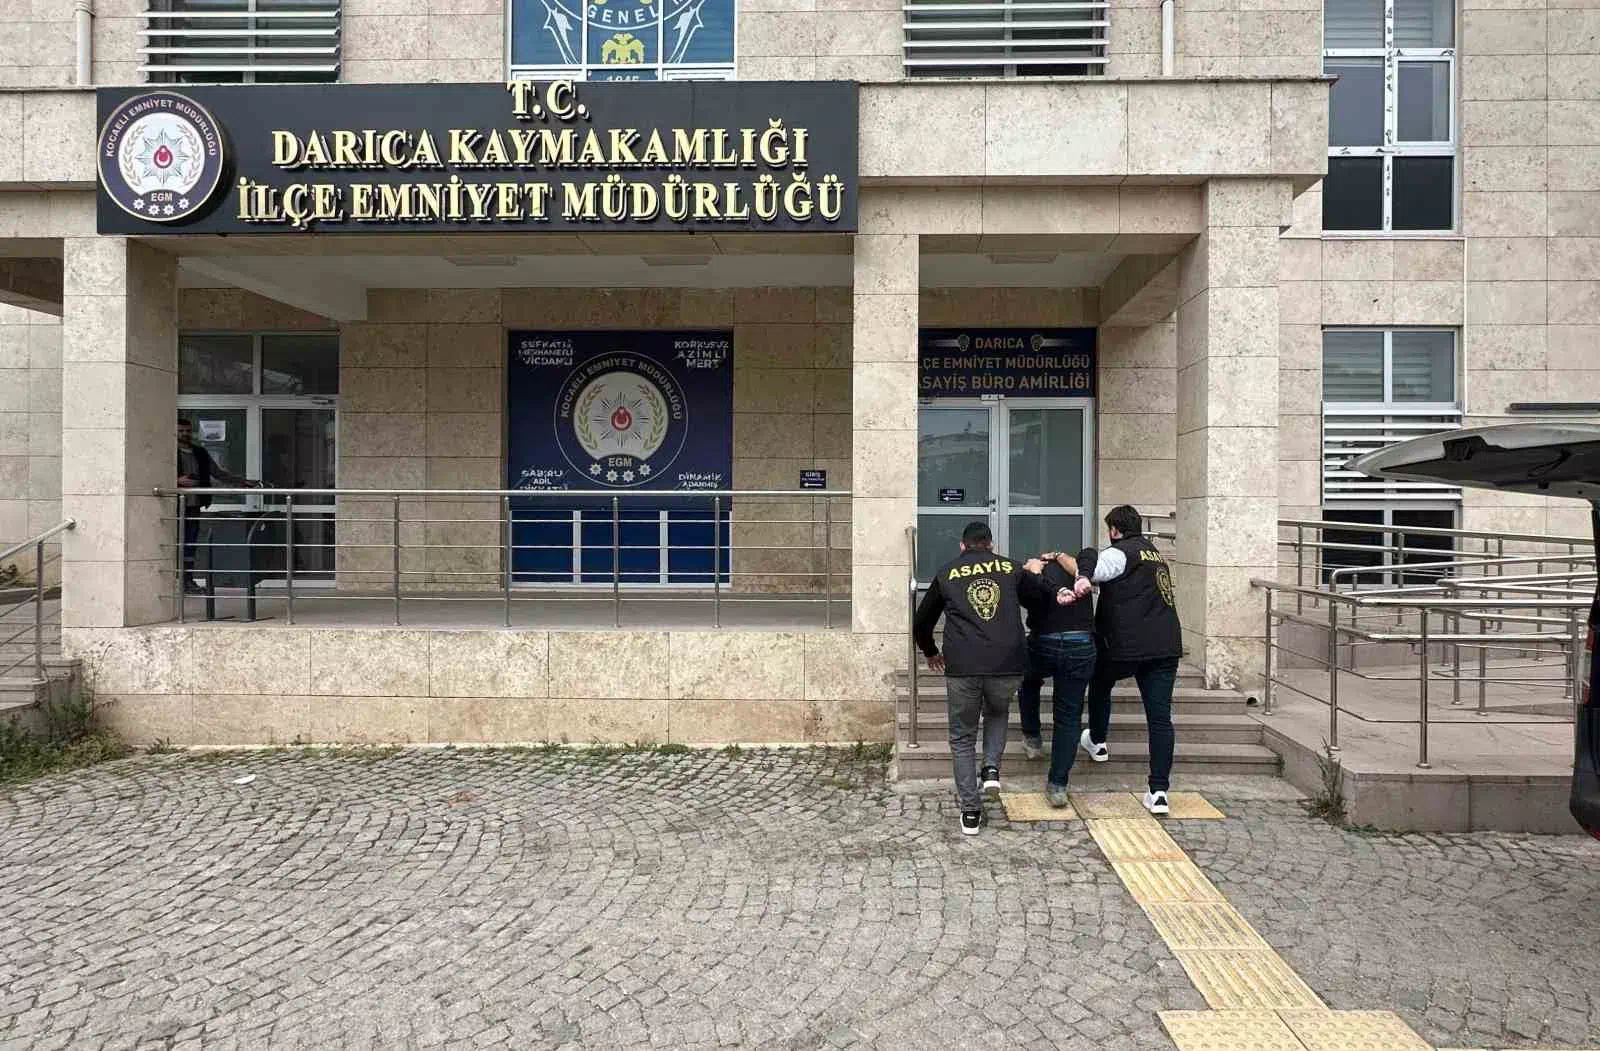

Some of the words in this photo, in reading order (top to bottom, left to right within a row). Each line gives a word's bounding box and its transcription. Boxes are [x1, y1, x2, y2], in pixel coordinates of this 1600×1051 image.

[587, 4, 659, 24] GENEL
[128, 98, 174, 117] EMNİYET
[507, 79, 588, 119] T.C.
[271, 129, 440, 168] DARICA
[448, 117, 809, 167] KAYMAKAMLIĞI
[151, 192, 173, 202] EGM
[236, 176, 342, 230] İLÇE
[350, 174, 552, 221] EMNİYET
[561, 171, 844, 222] MÜDÜRLÜĞÜ
[975, 337, 1025, 350] DARICA
[586, 358, 634, 374] EMNİYET
[918, 357, 940, 371] ÇE
[943, 354, 1001, 369] EMNİYET
[1005, 354, 1090, 369] MÜDÜRLÜĞÜ
[919, 374, 967, 392] SAYİŞ
[971, 373, 1015, 390] BÜRO
[1018, 372, 1090, 390] AMİRLİĞİ
[608, 457, 632, 467] EGM
[948, 559, 1013, 580] ASAYİŞ
